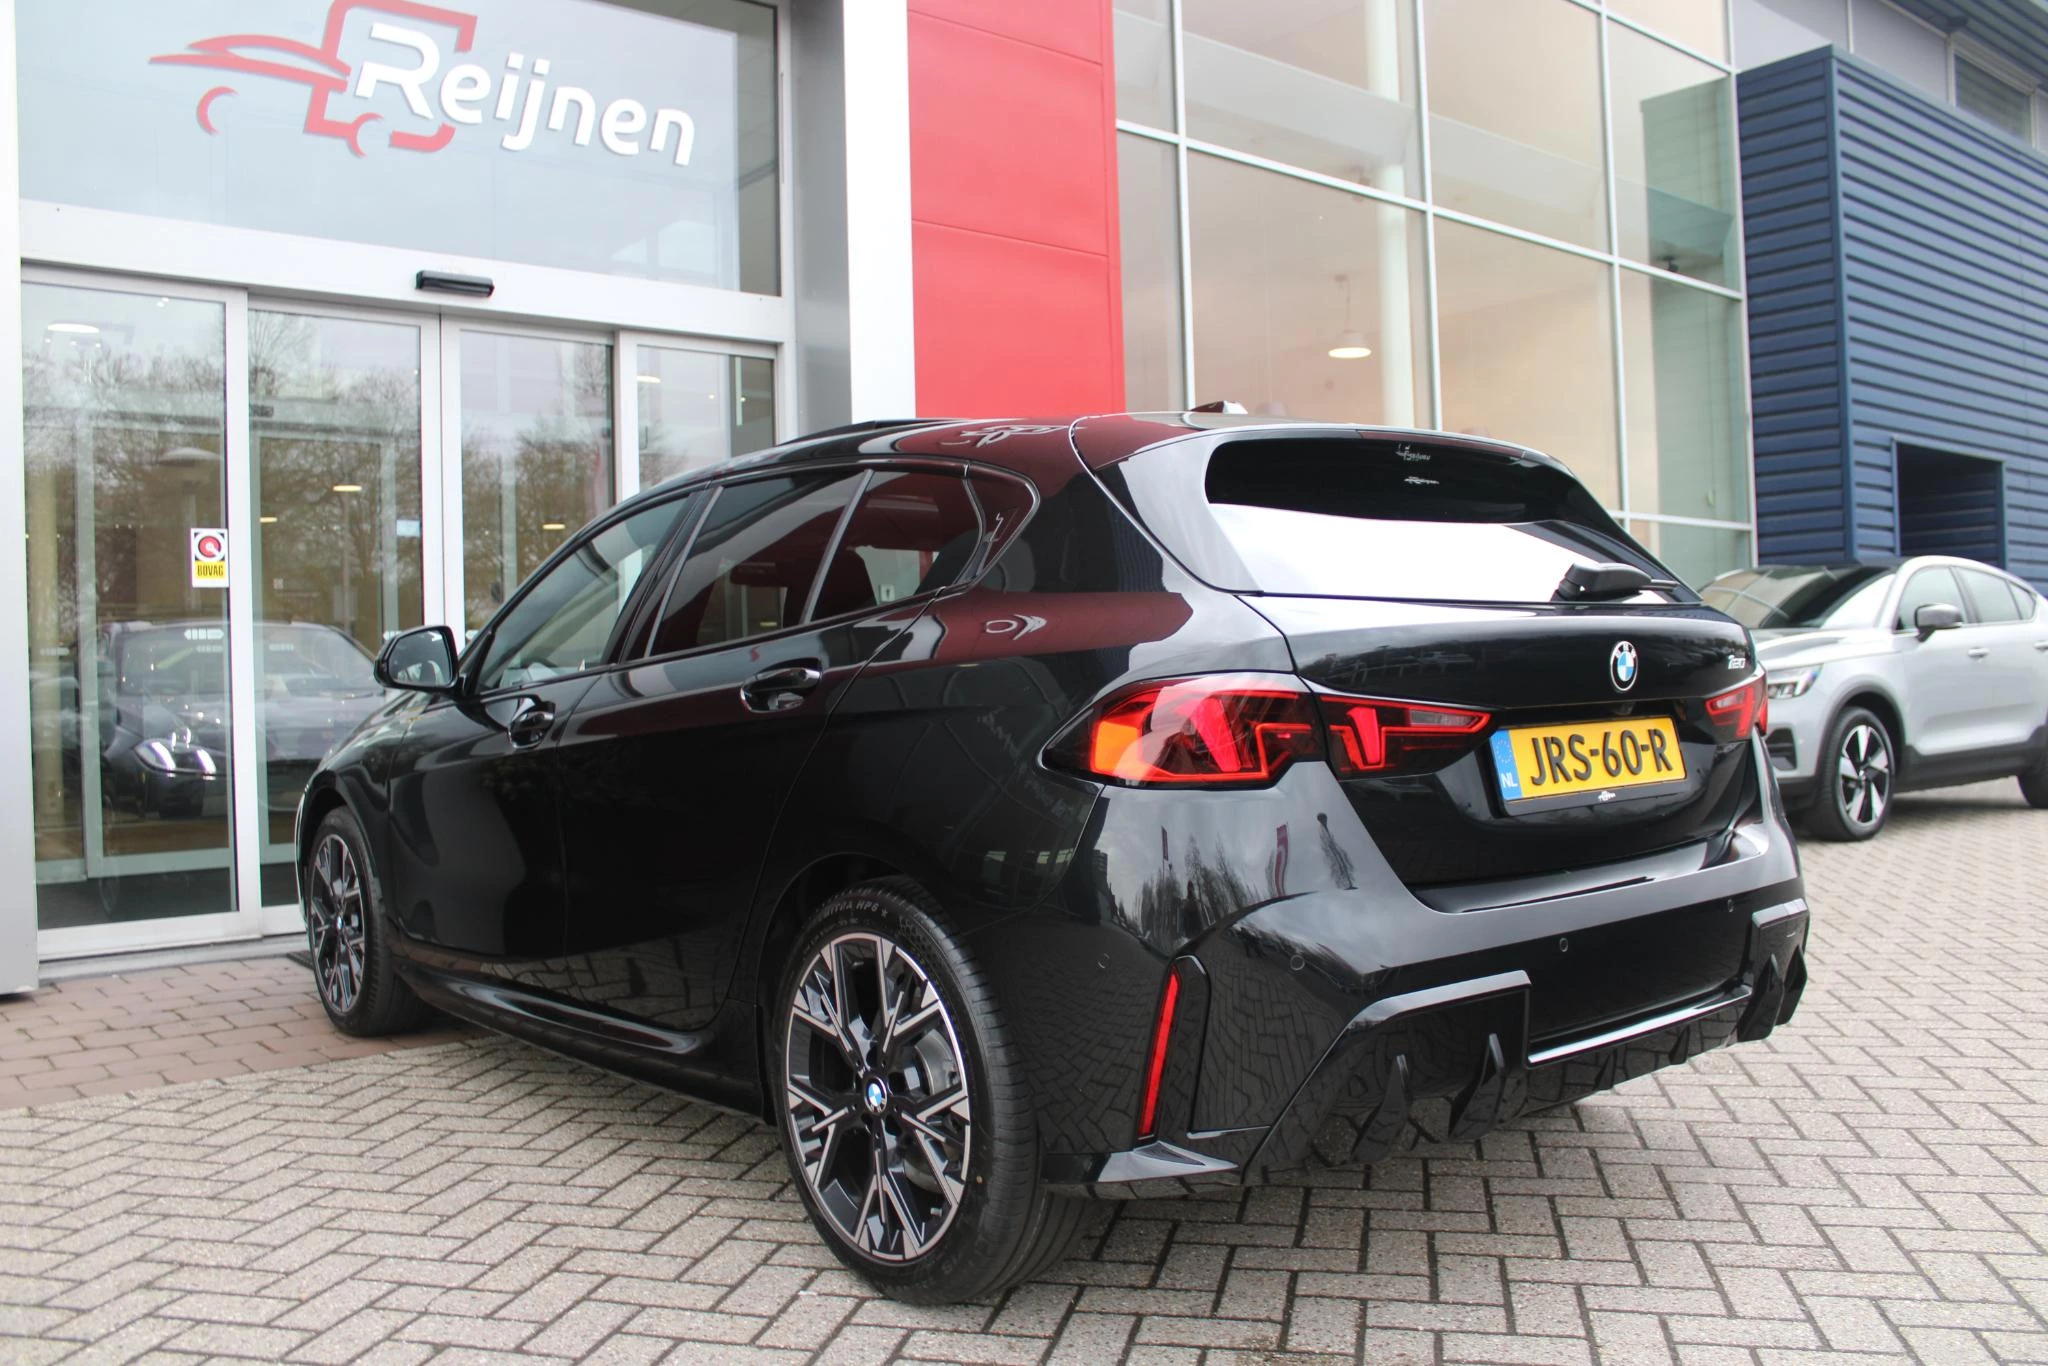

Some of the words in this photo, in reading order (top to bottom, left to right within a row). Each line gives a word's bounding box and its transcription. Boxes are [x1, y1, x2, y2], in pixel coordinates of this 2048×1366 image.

[355, 22, 696, 167] Reijnen
[197, 564, 224, 577] BOVAG
[1531, 728, 1673, 786] JRS-60-R
[1502, 772, 1518, 788] NL
